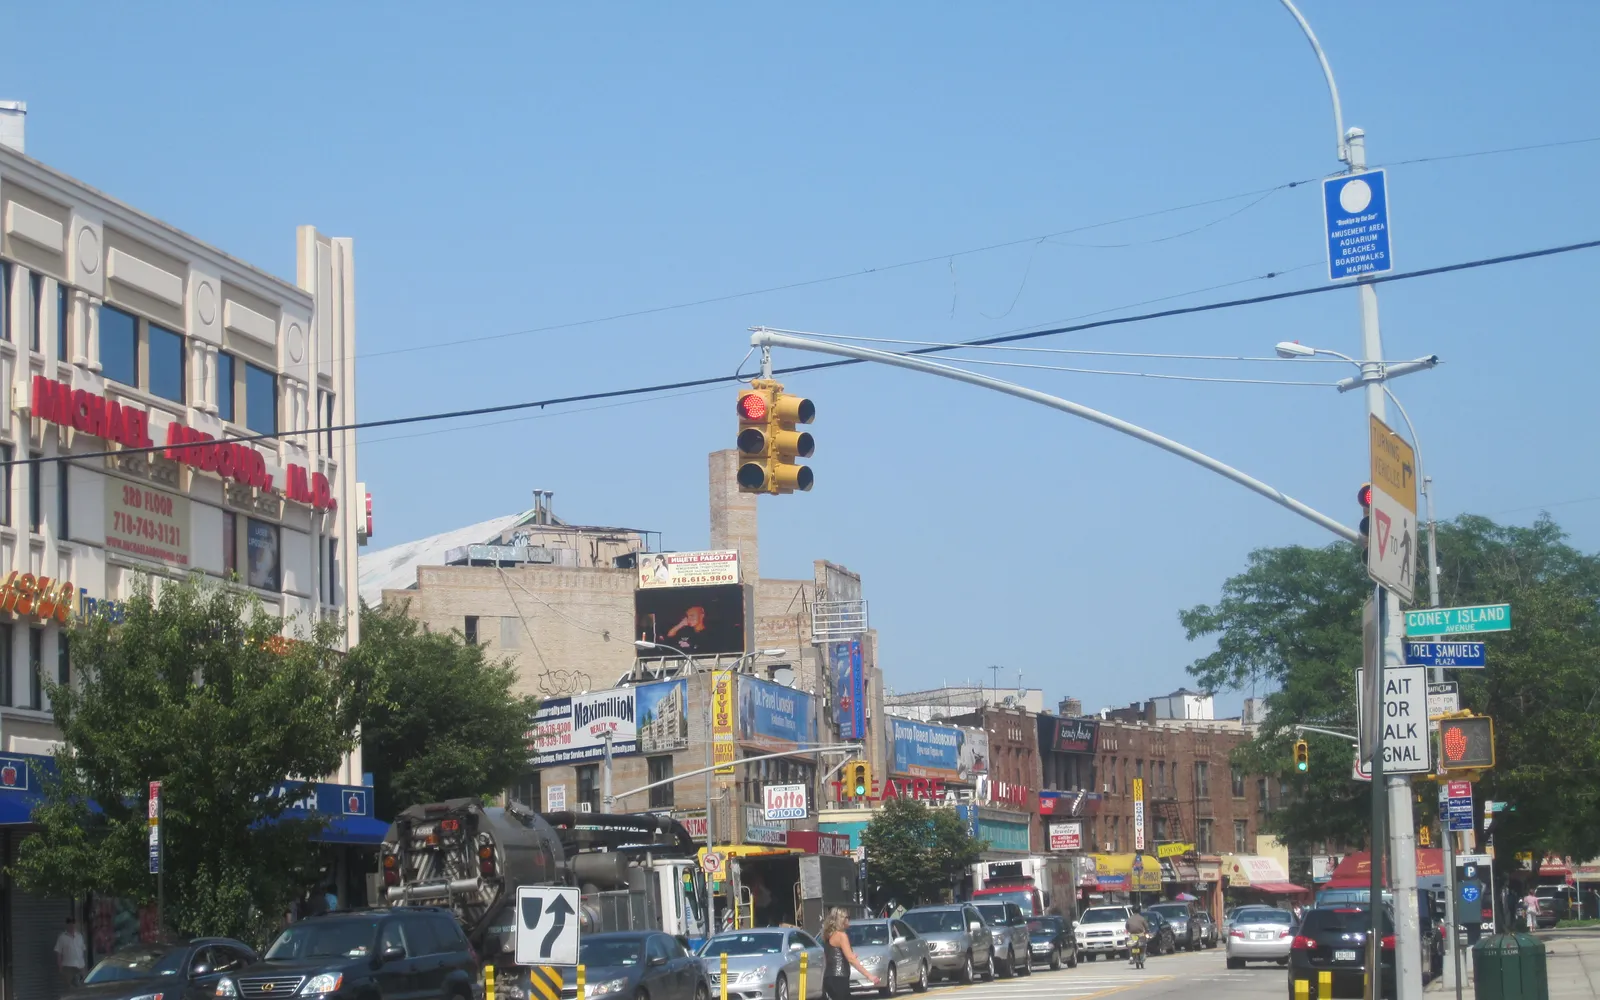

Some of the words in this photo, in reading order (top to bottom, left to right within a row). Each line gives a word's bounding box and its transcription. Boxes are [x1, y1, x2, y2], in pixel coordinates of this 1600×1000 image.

[1331, 226, 1366, 239] AMUSEMENT
[1369, 223, 1385, 232] AREA
[1340, 234, 1378, 247] AQUARIUM
[1342, 243, 1376, 255] BEACHES
[1335, 252, 1385, 266] BOARDWALKS
[1346, 263, 1375, 273] MARINA
[32, 375, 154, 449] MICHAEL
[164, 422, 274, 494] ABBOUD,
[286, 463, 338, 511] M.D.
[1373, 426, 1400, 463] TURNING
[1375, 455, 1400, 489] VEHICLES
[123, 485, 142, 508] 3RD
[144, 491, 173, 518] FLOOR
[113, 510, 181, 547] 718-743-3121
[1390, 535, 1398, 556] TO
[672, 575, 734, 584] 718.615.9800
[1408, 611, 1451, 627] CONEY
[1457, 607, 1505, 623] ISLAND
[1445, 624, 1475, 632] AVENUE
[1408, 645, 1433, 659] JOEL
[1436, 644, 1480, 658] SAMUELS
[1385, 678, 1412, 695] AIT
[716, 681, 728, 725] DRIVING
[1384, 701, 1410, 717] OR
[574, 695, 634, 731] MaximillioN
[1384, 722, 1418, 740] ALK
[1383, 745, 1421, 762] GNAL
[831, 777, 946, 802] TEATRE
[767, 789, 803, 809] Lotto
[1160, 845, 1182, 855] LIQUOR
[1467, 866, 1475, 877] P
